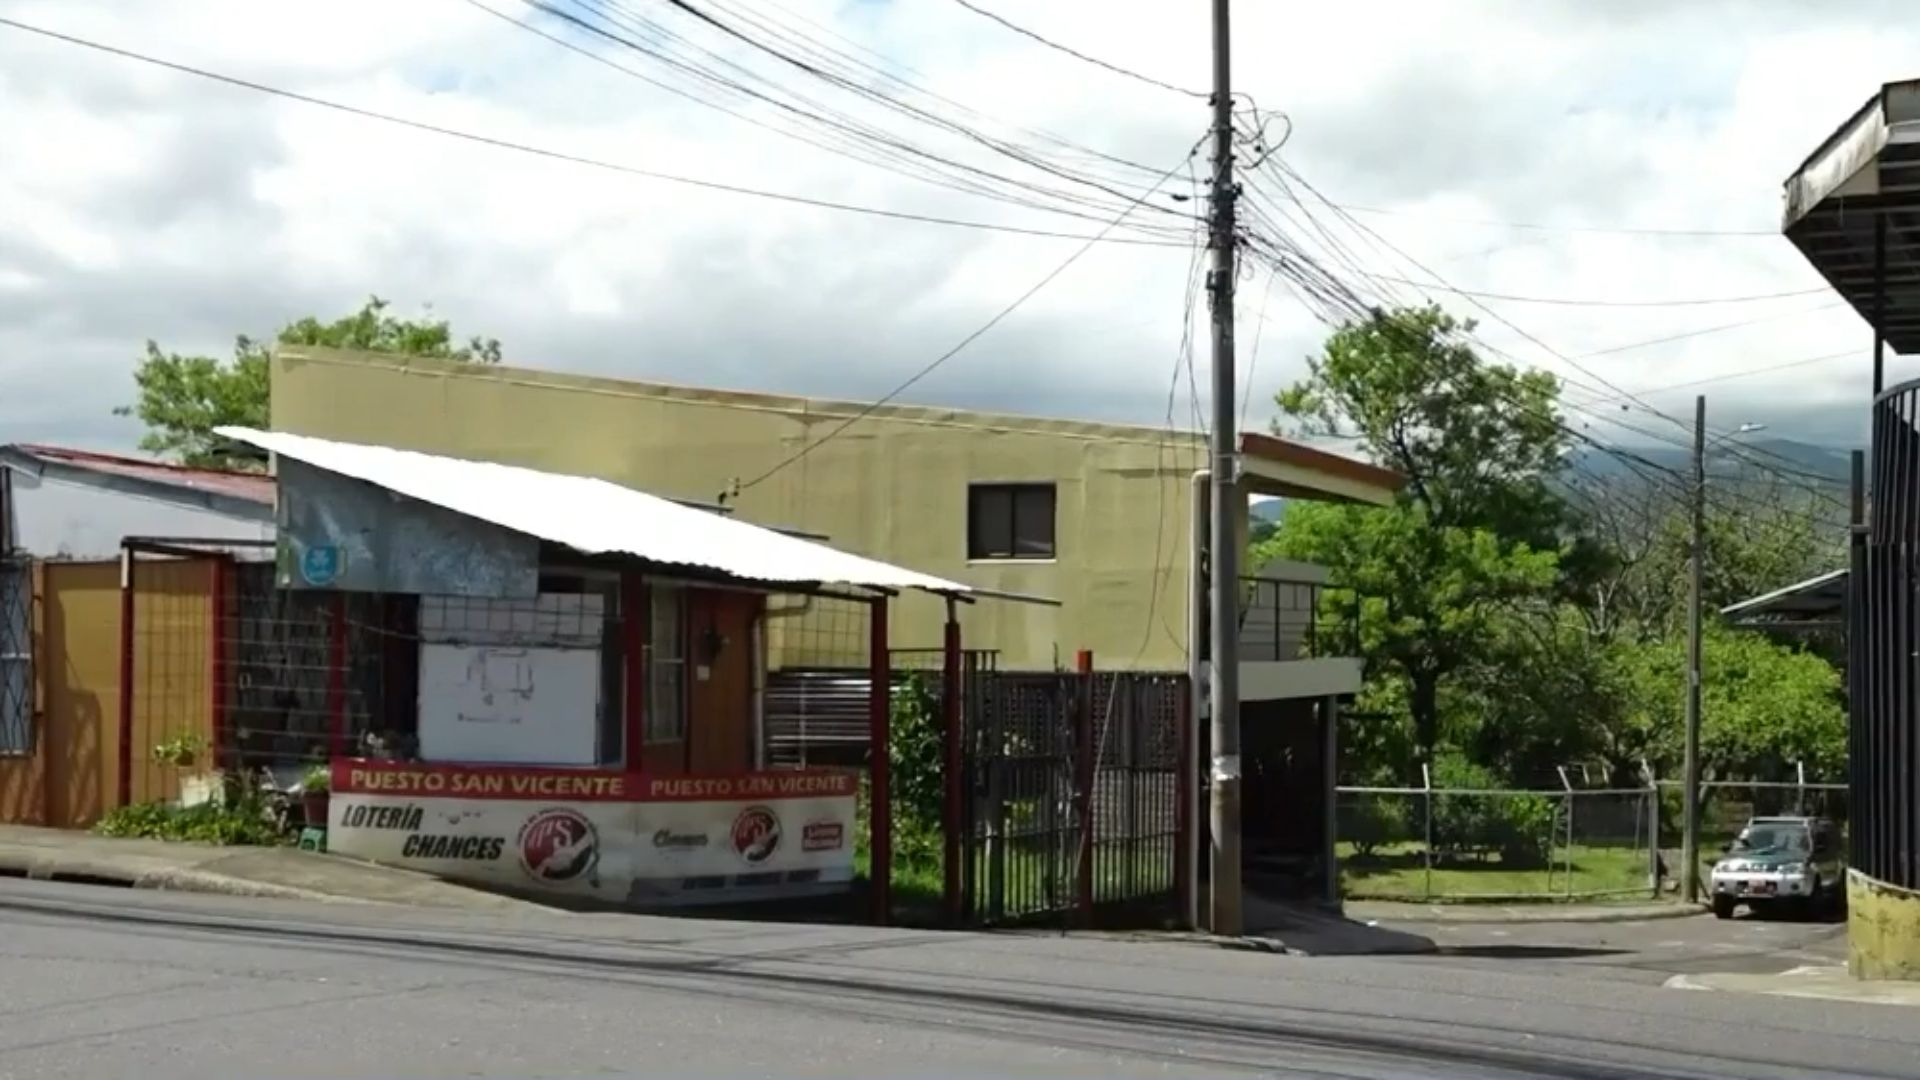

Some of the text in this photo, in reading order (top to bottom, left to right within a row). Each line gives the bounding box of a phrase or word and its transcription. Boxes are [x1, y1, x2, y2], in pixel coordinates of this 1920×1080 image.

[350, 769, 624, 796] PUESTO SAN VICENTE
[650, 775, 848, 796] PUESTO SAN VICENTE
[341, 803, 424, 830] LOTERÍA
[402, 834, 506, 860] CHANCES
